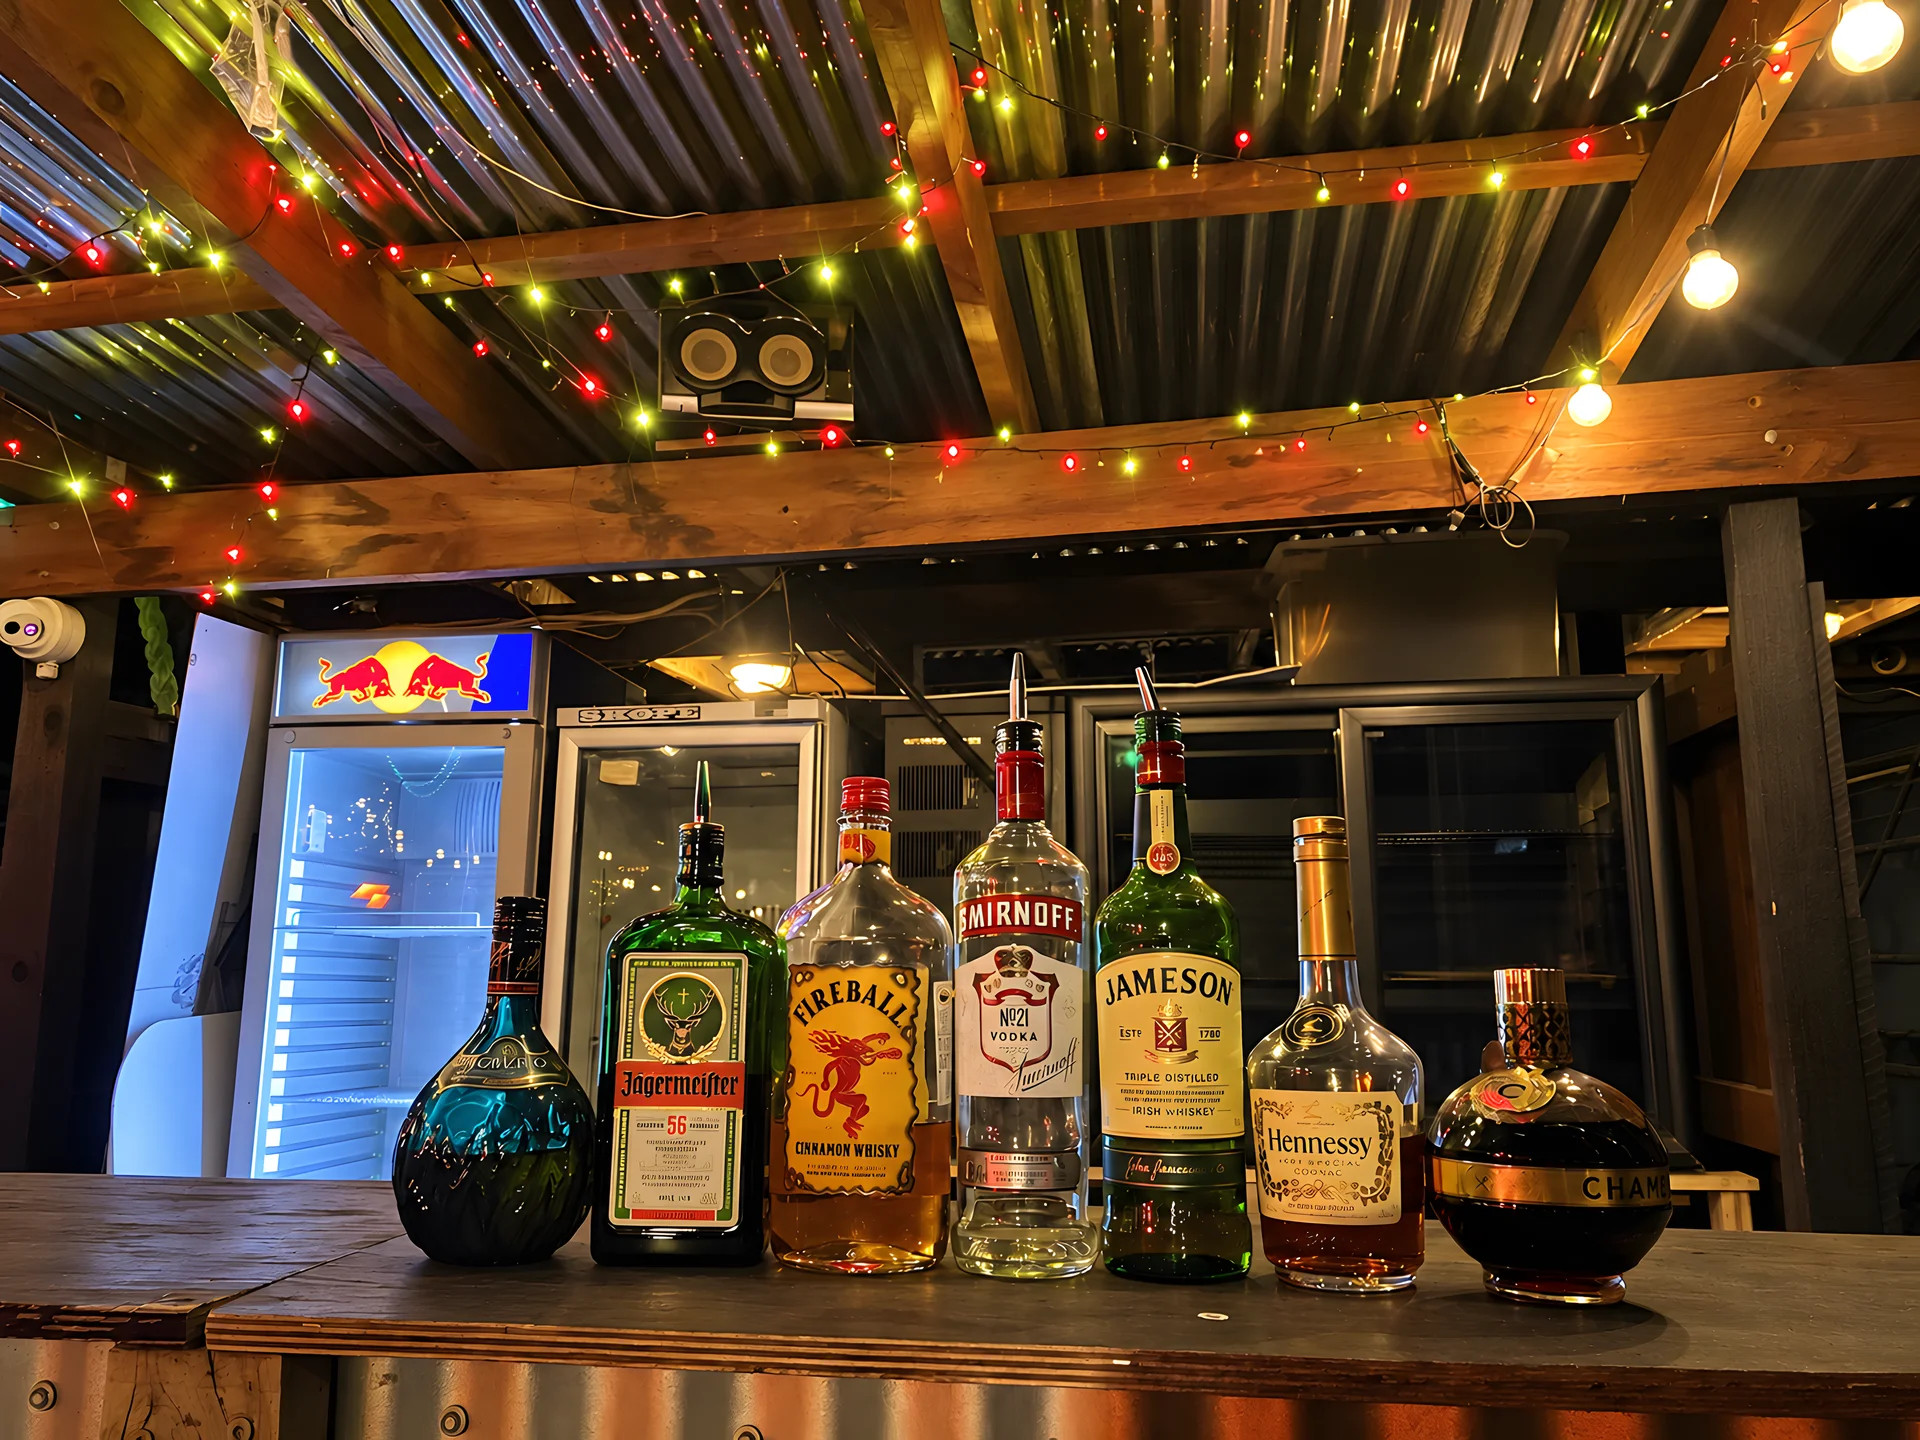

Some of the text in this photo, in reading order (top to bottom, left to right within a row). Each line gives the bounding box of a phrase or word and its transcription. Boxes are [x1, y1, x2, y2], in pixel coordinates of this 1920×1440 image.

[578, 706, 700, 723] SKOPE
[959, 900, 1075, 932] SMIRNOFF
[1106, 967, 1232, 1006] JAMESON
[793, 980, 907, 1028] FIREBALL
[990, 1031, 1038, 1041] VODKA
[1199, 1029, 1221, 1038] 1780
[1125, 1072, 1219, 1083] TRIPLE DISTILLED
[1132, 1106, 1215, 1116] IRISH WHISKEY
[667, 1115, 687, 1135] 56
[795, 1141, 900, 1158] CINNAMON WHISKY
[1268, 1128, 1372, 1159] Hennessy
